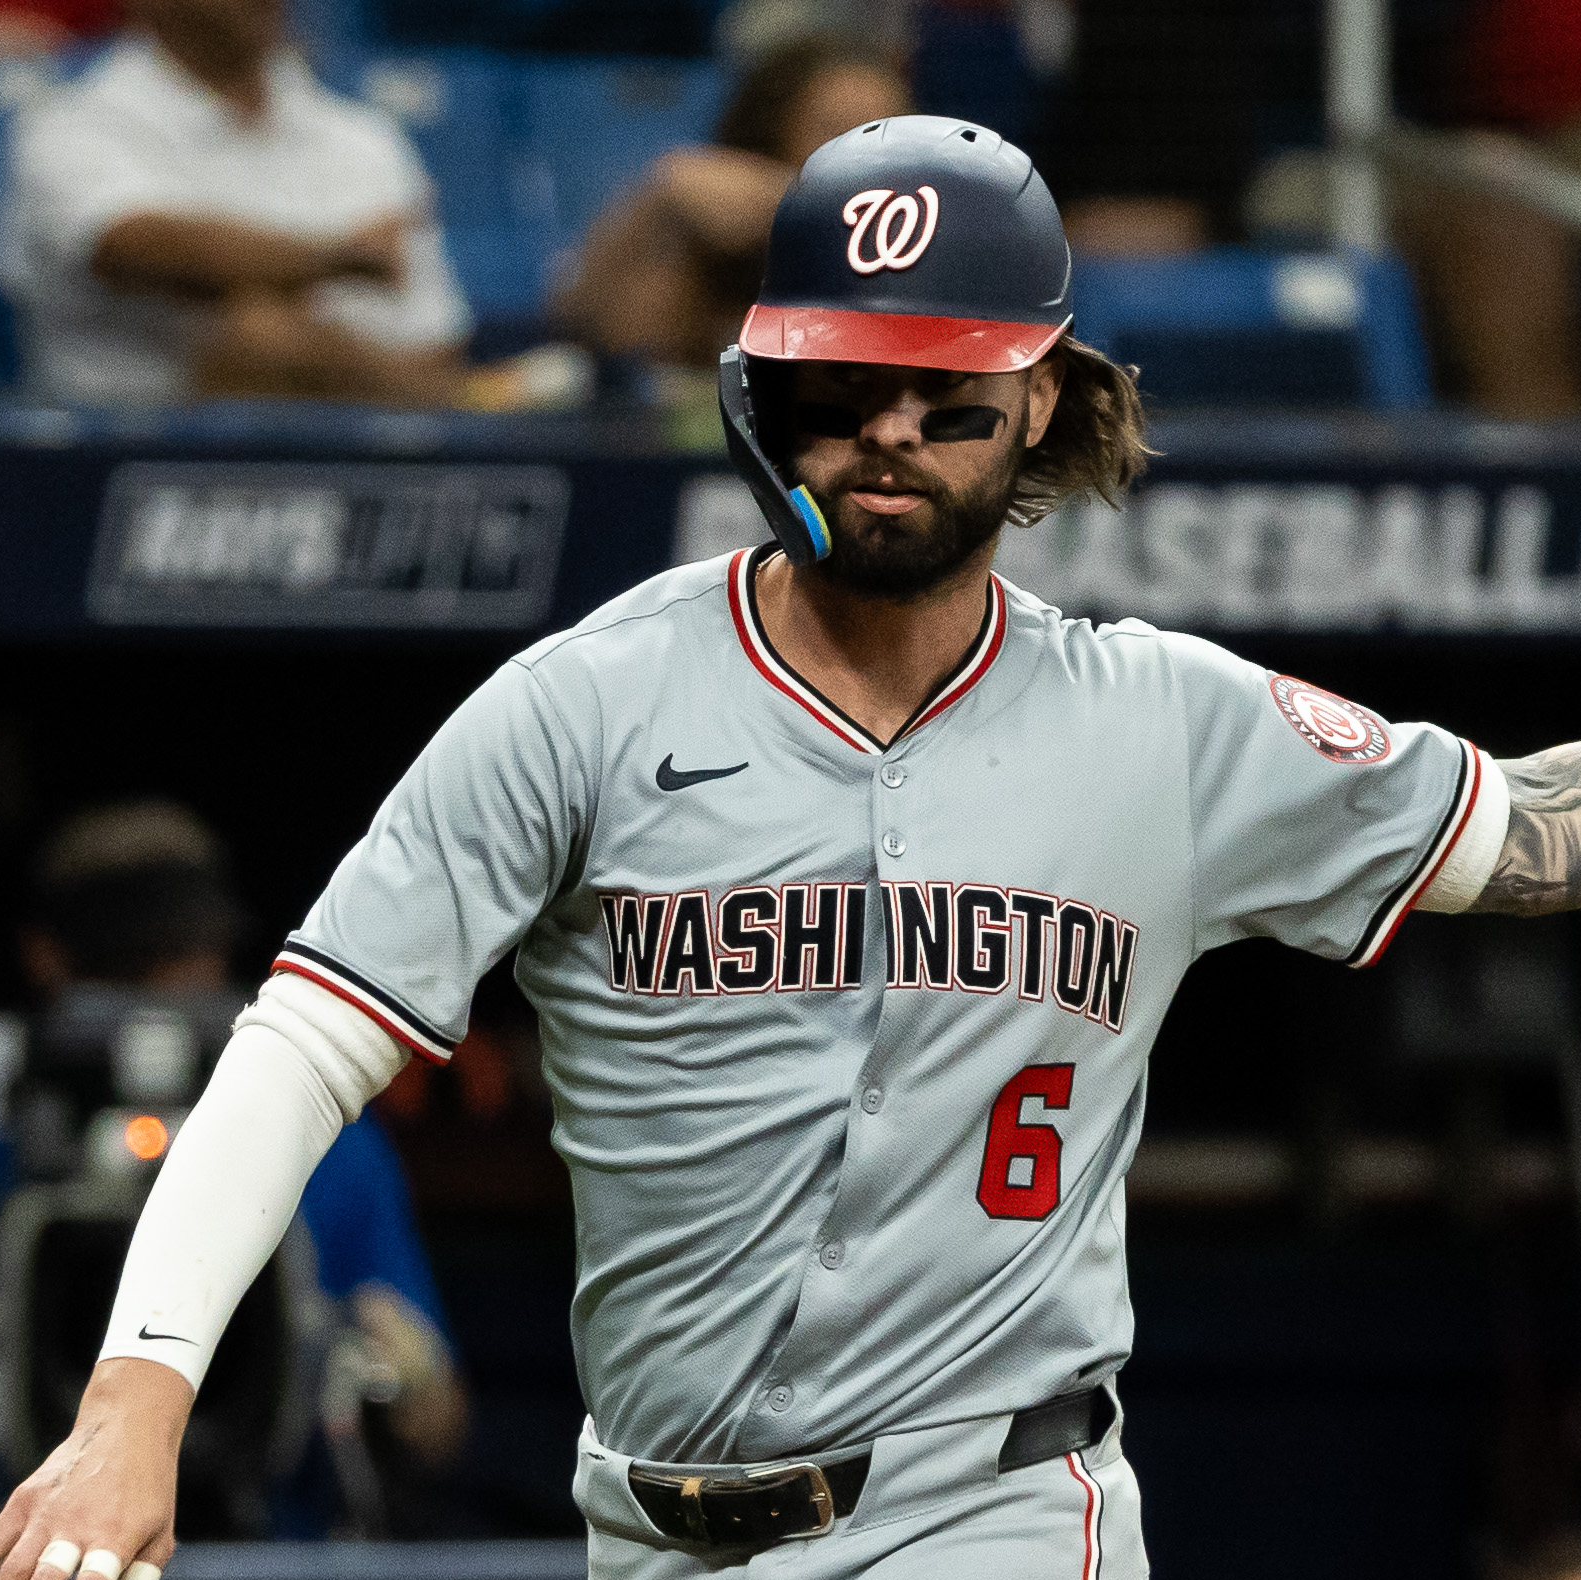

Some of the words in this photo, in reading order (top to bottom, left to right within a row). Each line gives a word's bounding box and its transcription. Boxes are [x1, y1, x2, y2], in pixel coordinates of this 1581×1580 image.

[842, 185, 939, 276] W
[598, 880, 1140, 1036] WASHINGTON
[975, 1061, 1077, 1222] 6
